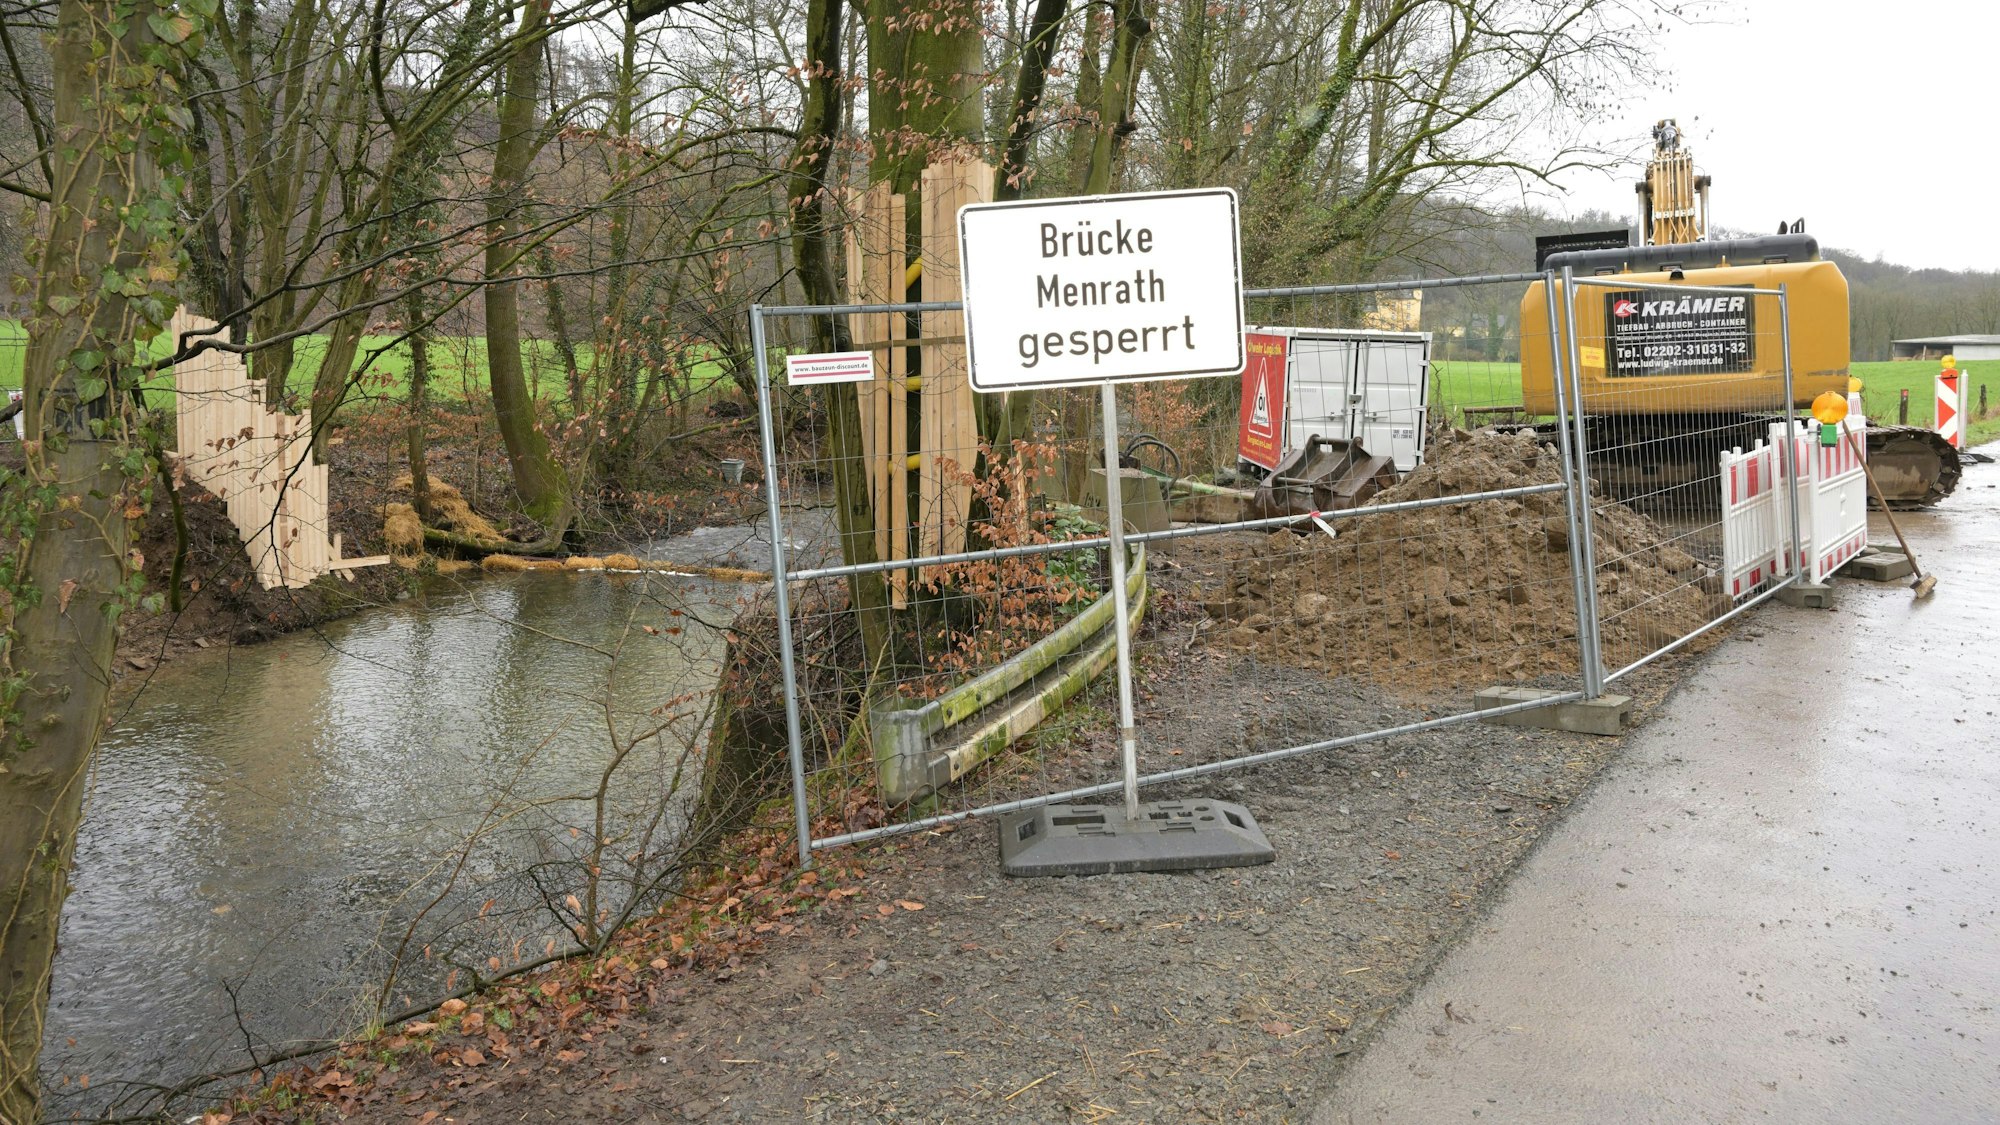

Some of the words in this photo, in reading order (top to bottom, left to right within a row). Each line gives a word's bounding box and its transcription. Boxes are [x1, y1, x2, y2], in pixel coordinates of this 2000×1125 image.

[1040, 219, 1153, 258] Brücke
[1036, 269, 1165, 308] Menrath
[1641, 295, 1746, 317] KRÄMER
[1617, 323, 1649, 332] TIEFBAU
[1655, 321, 1693, 330] ABBRUCH
[1699, 318, 1746, 327] CONTAINER
[1018, 315, 1195, 368] gesperrt
[1617, 347, 1640, 359] Tel.
[1644, 342, 1746, 357] 02202-31031-32
[1617, 356, 1723, 369] www.ludwig-kraemer.de
